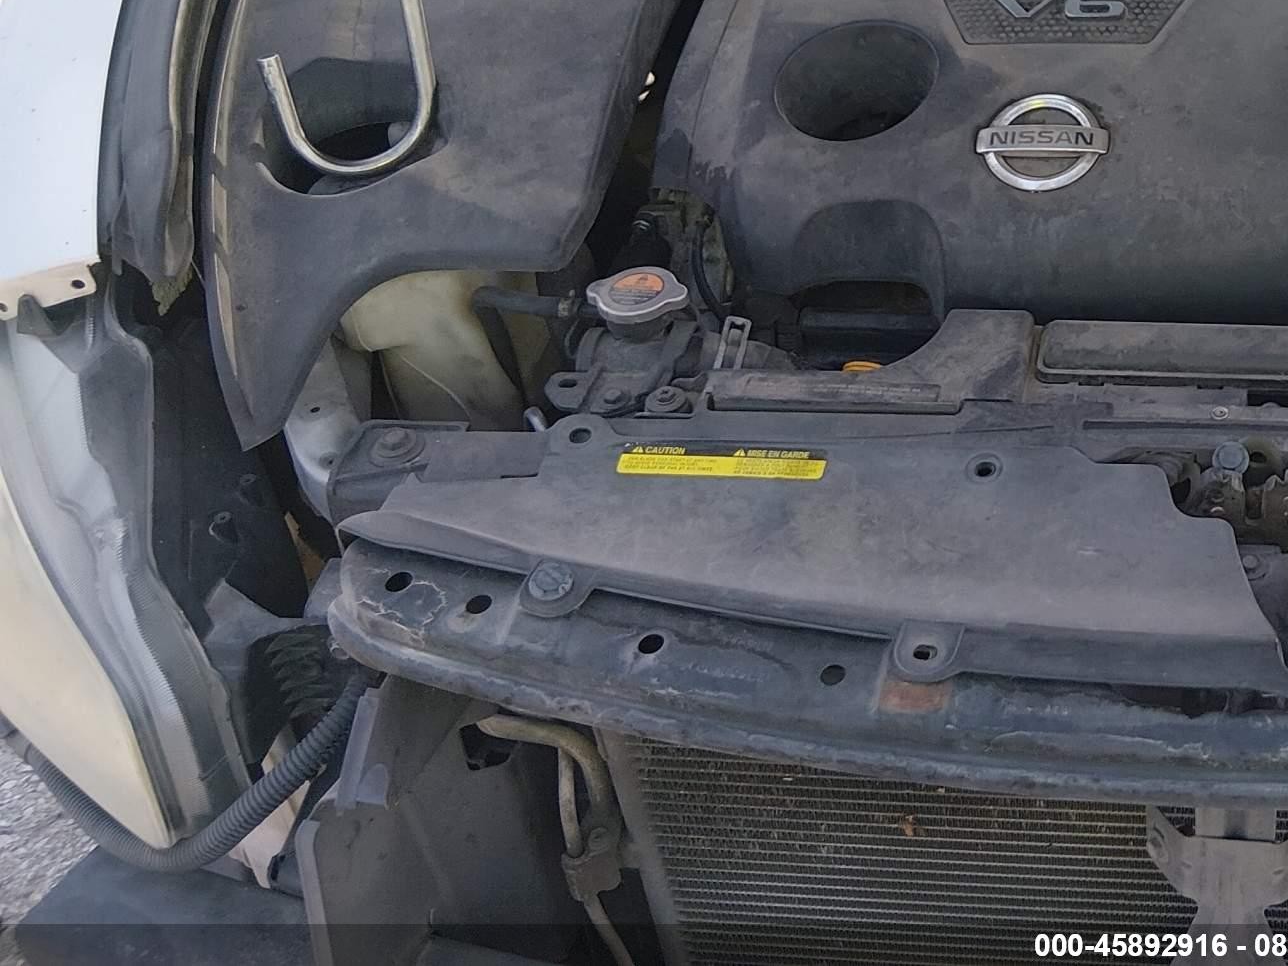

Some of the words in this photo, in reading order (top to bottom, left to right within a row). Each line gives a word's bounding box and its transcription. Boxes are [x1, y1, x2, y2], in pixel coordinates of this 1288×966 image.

[989, 130, 1094, 146] NISSAN
[644, 445, 686, 455] CAUTION
[747, 448, 768, 458] MISE
[767, 449, 781, 458] EN
[780, 450, 811, 460] GARDE
